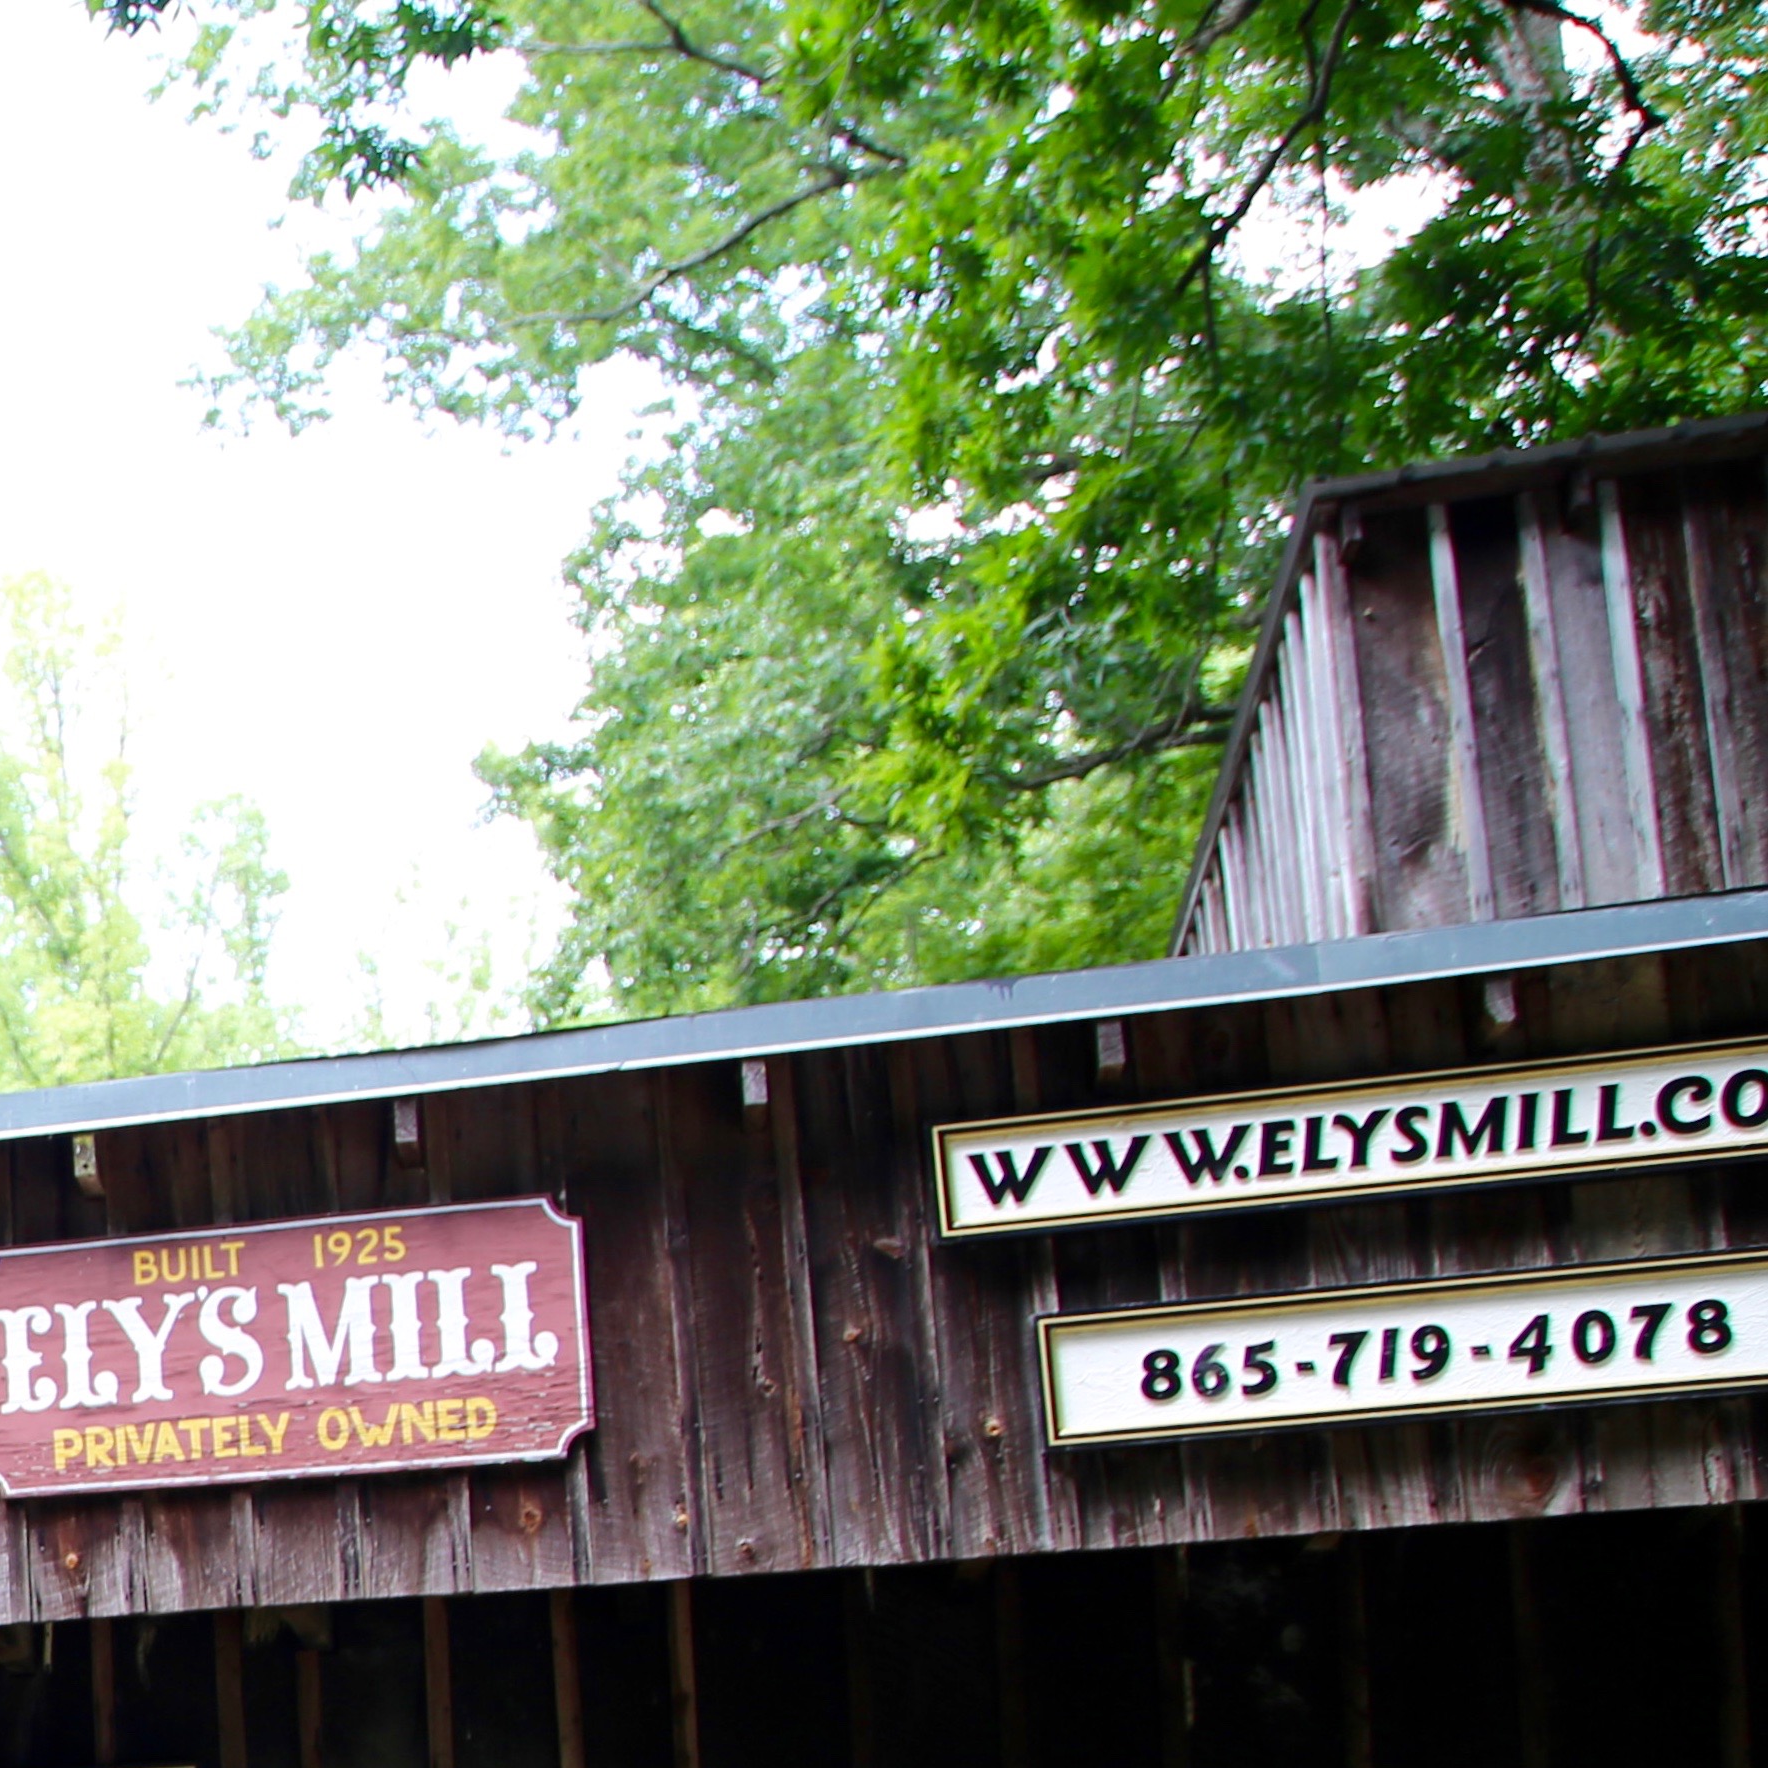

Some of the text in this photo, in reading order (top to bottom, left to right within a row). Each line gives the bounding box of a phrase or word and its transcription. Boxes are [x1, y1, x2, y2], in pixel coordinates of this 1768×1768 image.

[133, 1226, 406, 1286] BUILT 1925
[277, 1260, 560, 1392] MILL
[1141, 1299, 1734, 1402] 865-719-4078
[54, 1396, 498, 1471] PRIVATELY OWNED
